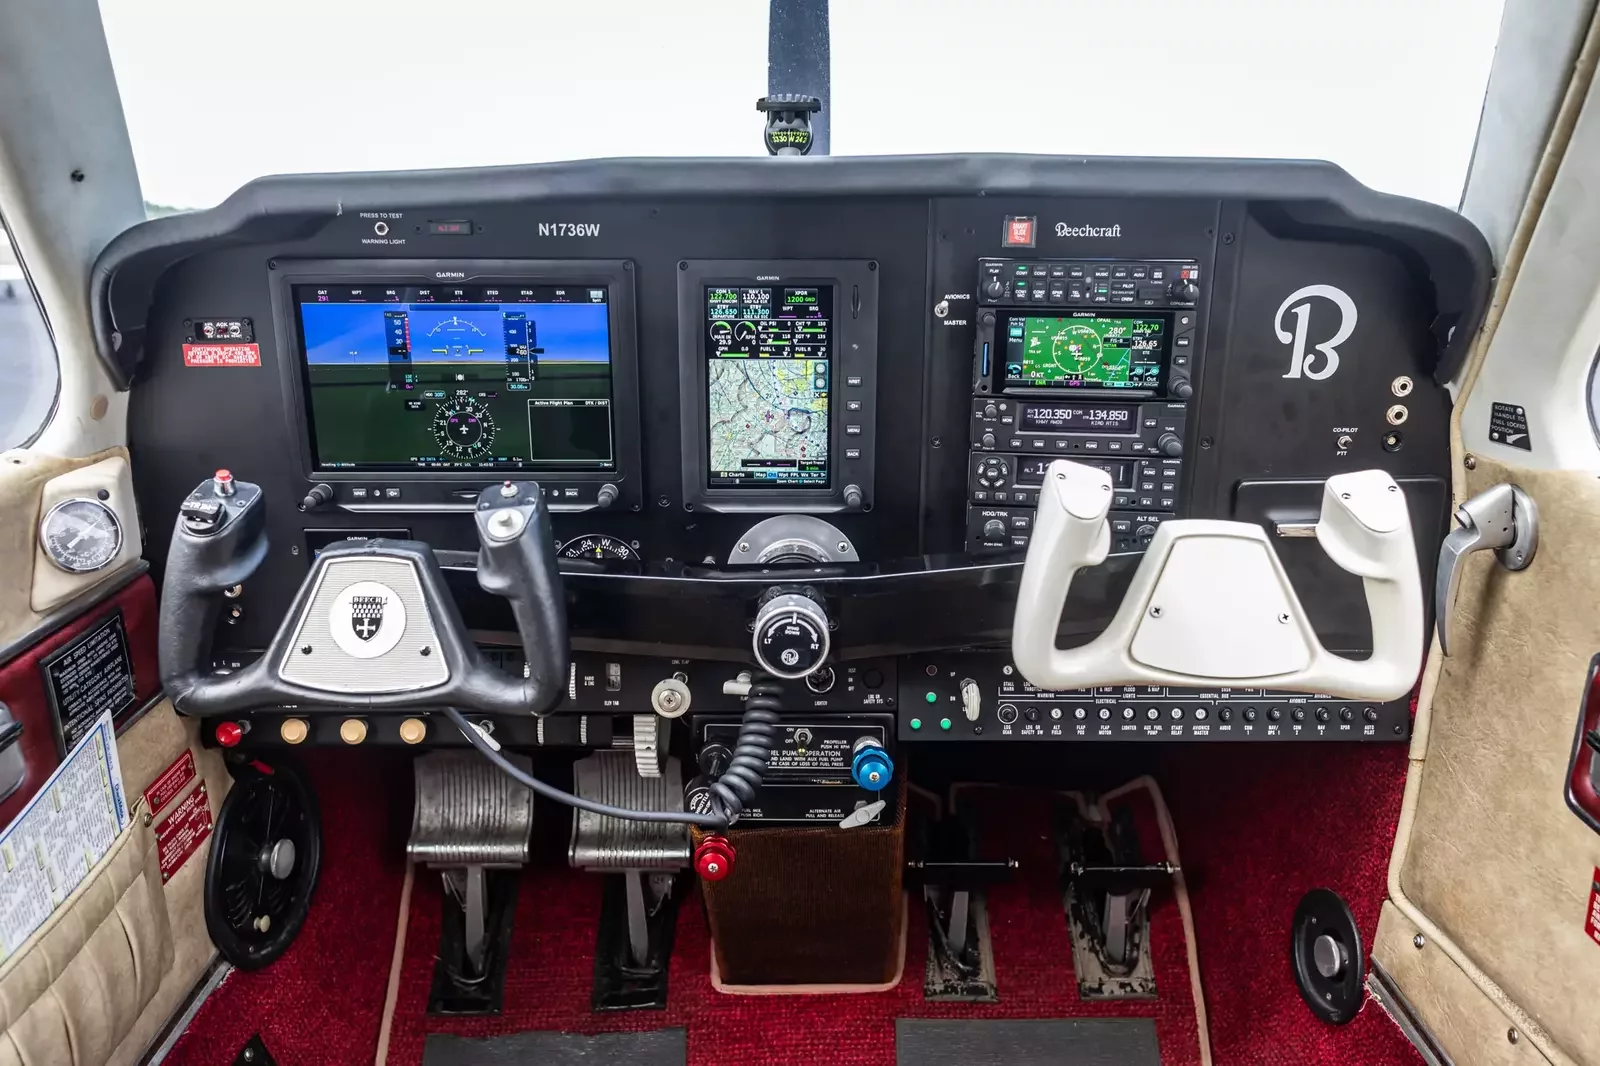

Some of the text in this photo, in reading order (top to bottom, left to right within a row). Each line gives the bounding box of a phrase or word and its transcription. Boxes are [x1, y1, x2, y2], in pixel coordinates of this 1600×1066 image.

[538, 222, 600, 238] N1736W
[1055, 222, 1122, 238] Beechcraft
[1274, 284, 1358, 380] B
[1034, 408, 1072, 419] 120.350
[1089, 410, 1128, 420] 134.850
[580, 539, 592, 548] 24
[617, 545, 629, 556] 30
[63, 656, 72, 666] AIR
[73, 646, 87, 660] SPEED
[64, 706, 93, 732] INTENTIONAL
[168, 794, 195, 825] WARNING
